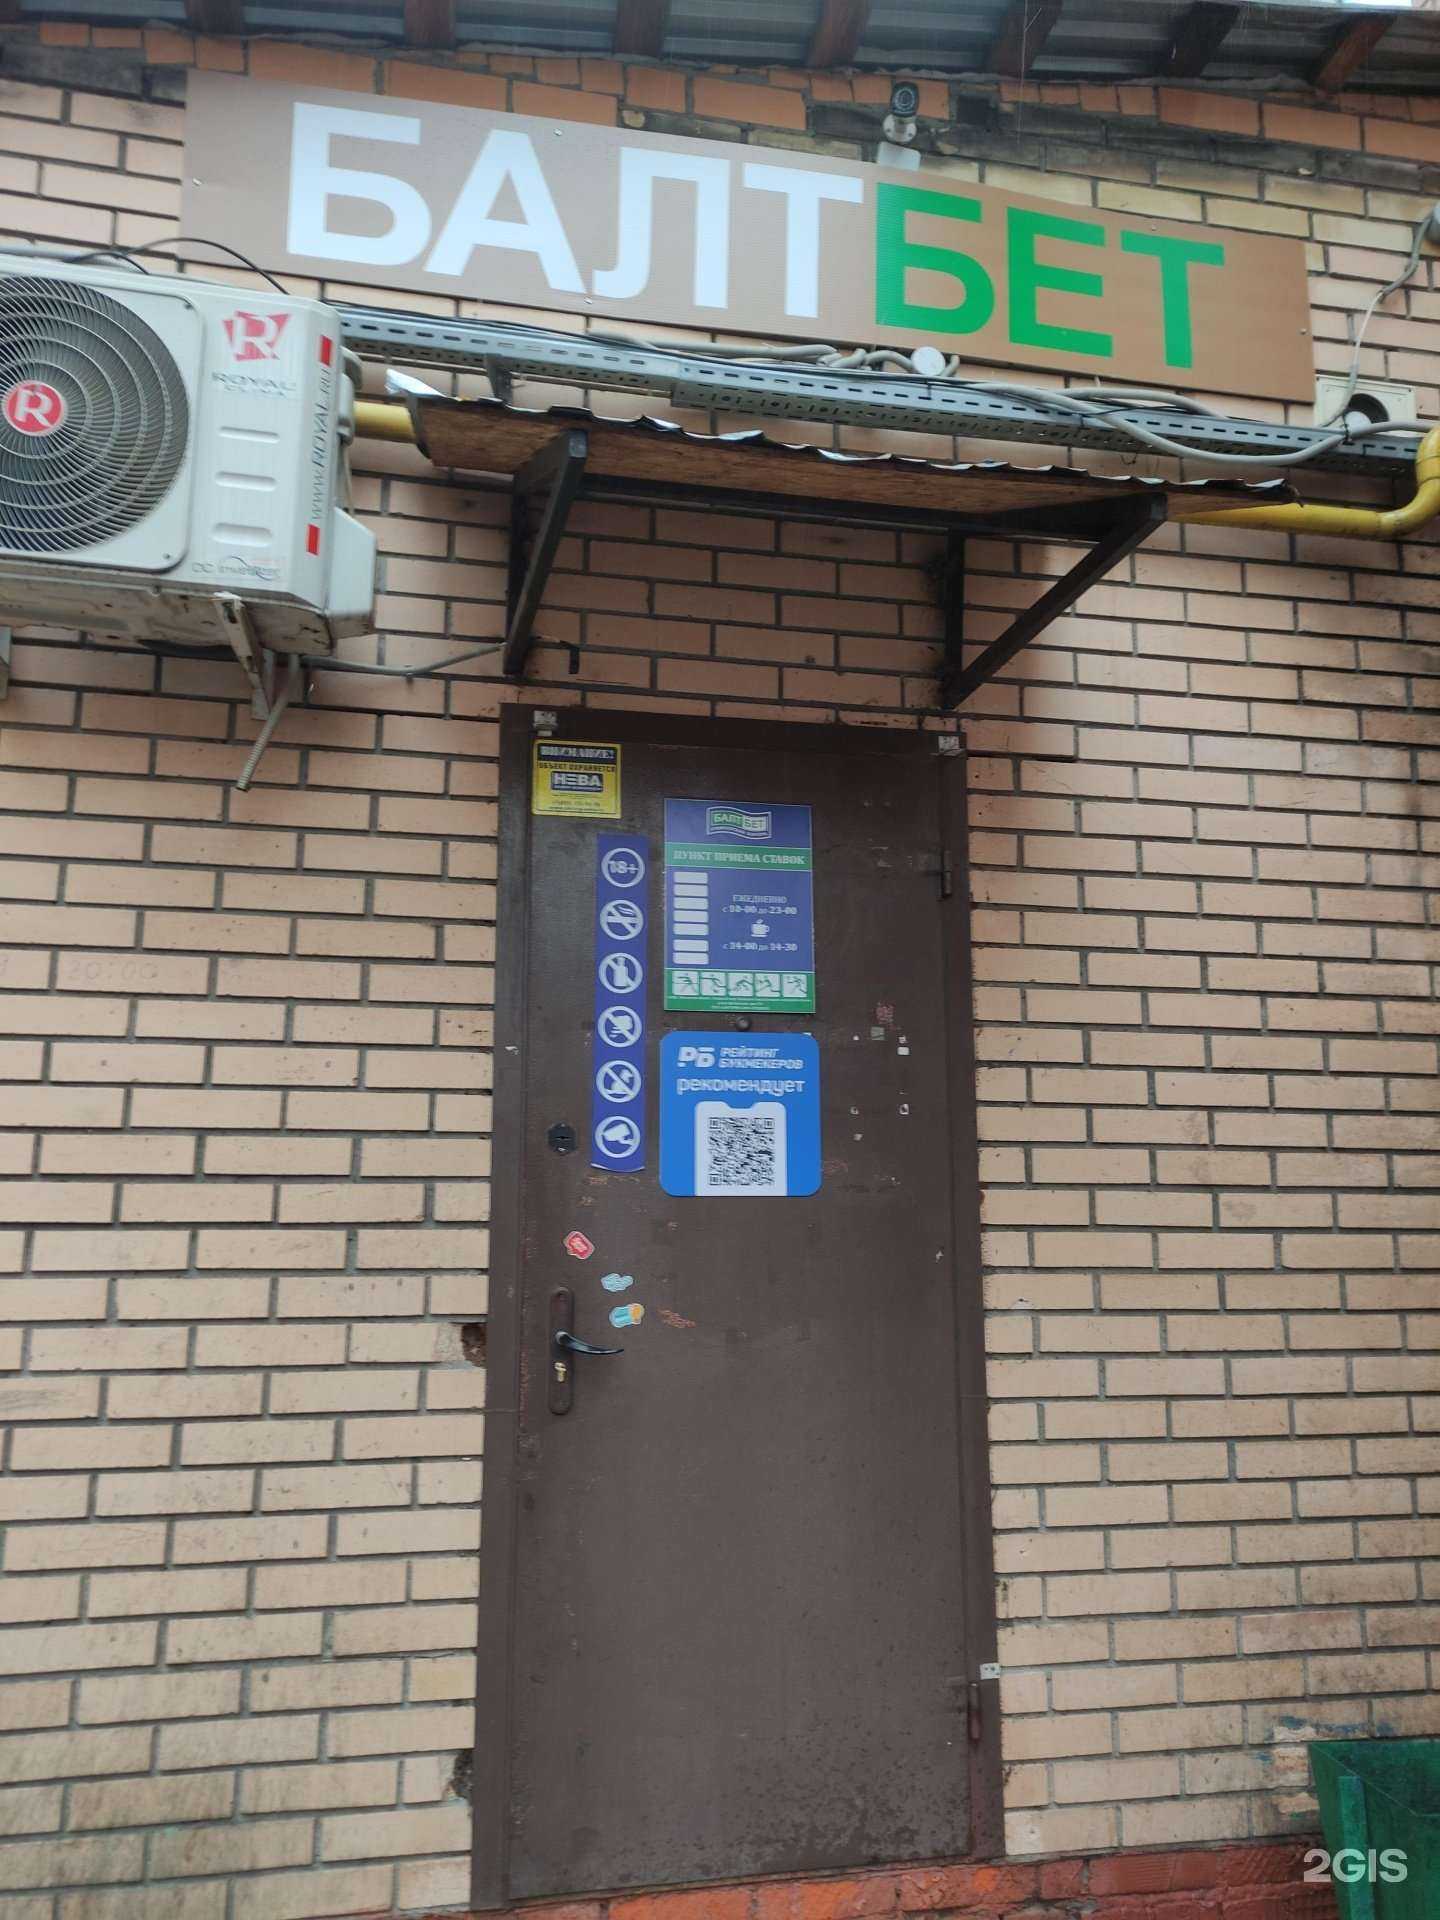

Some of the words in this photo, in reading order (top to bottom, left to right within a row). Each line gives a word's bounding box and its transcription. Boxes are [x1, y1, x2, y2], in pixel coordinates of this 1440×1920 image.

[553, 772, 602, 787] НЕВА
[672, 850, 713, 861] ПУНКТ
[714, 852, 761, 863] ПРИЕМА
[762, 854, 806, 865] СТАВОК
[608, 860, 639, 874] 18+
[719, 1045, 780, 1058] РЕЙТИНГ
[718, 1058, 804, 1070] БУКМЕКЕРОВ
[677, 1078, 806, 1097] рекомендует
